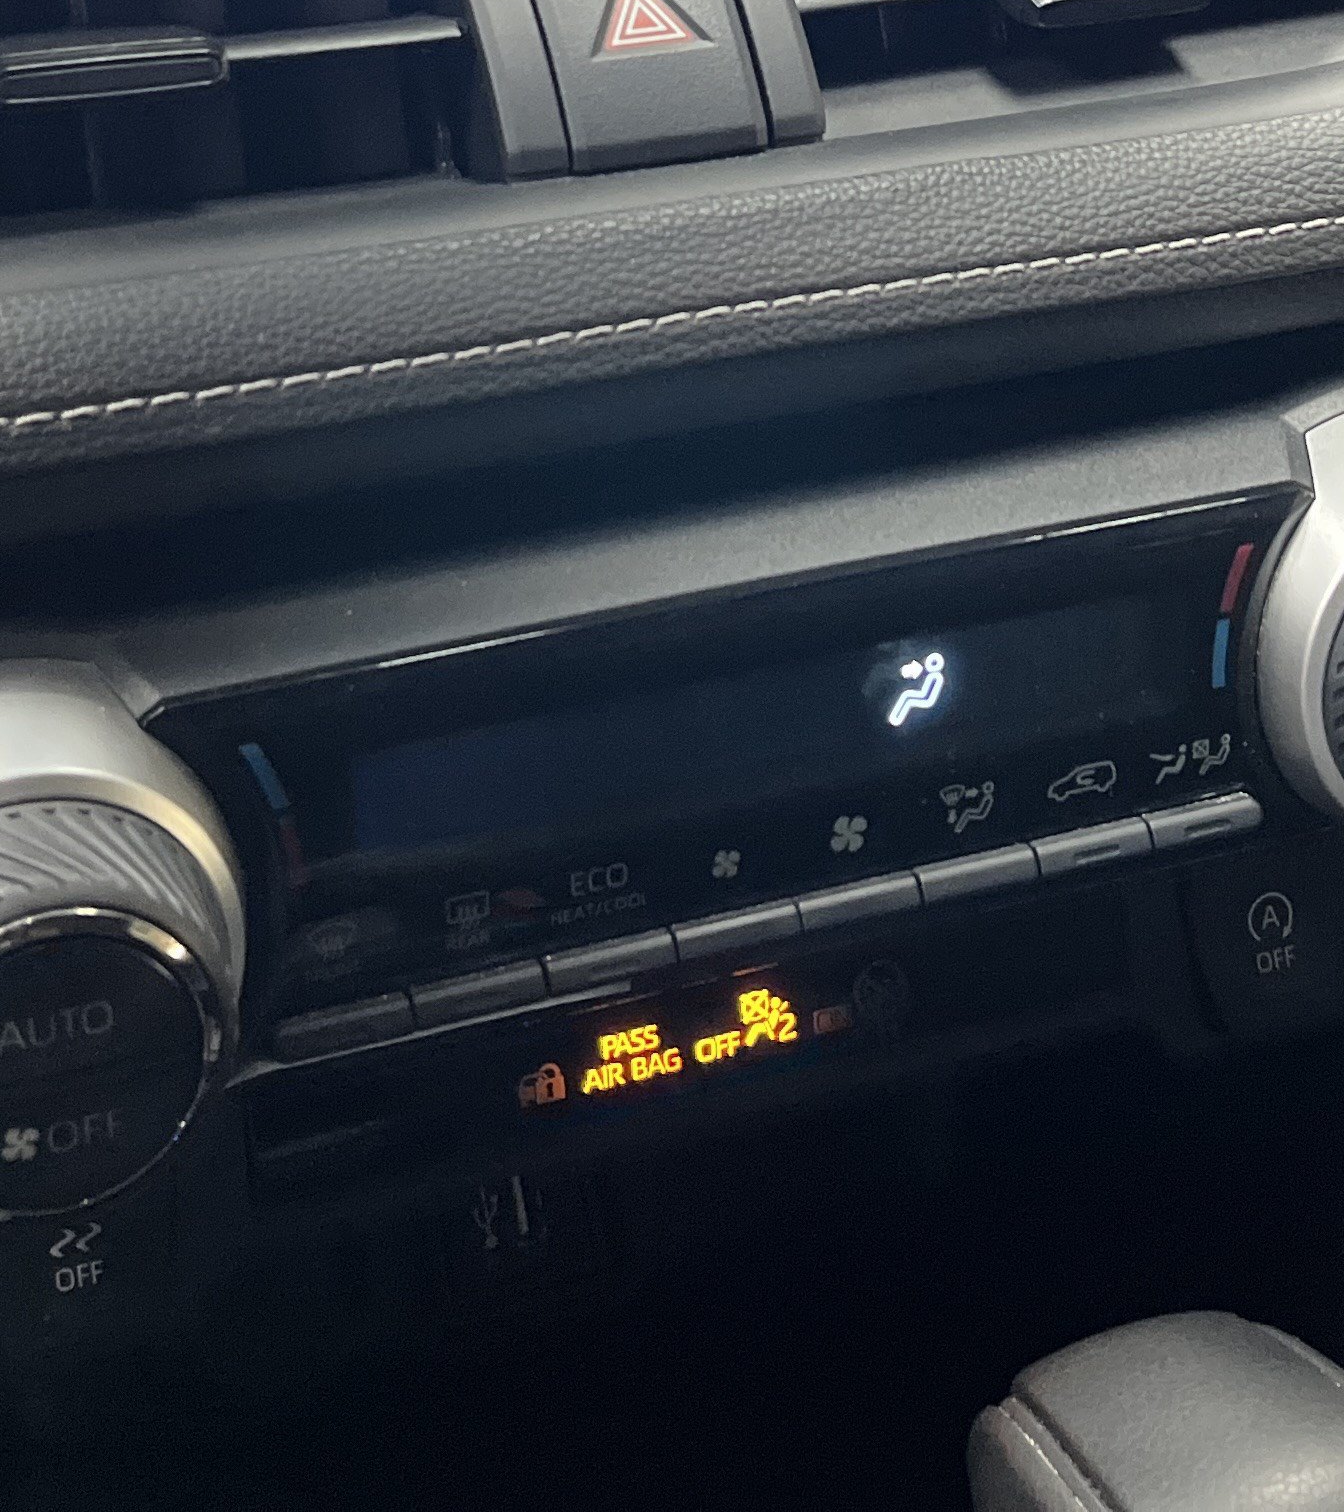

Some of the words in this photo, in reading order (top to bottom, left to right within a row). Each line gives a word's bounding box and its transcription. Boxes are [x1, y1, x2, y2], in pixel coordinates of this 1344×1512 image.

[569, 861, 630, 898] ECO
[1257, 944, 1297, 974] OFF
[599, 1024, 661, 1061] PASS
[581, 1061, 627, 1095] AIR
[629, 1048, 684, 1083] BAG
[693, 1029, 742, 1065] OFF
[45, 1106, 125, 1155] OFF
[54, 1260, 106, 1295] OFF
